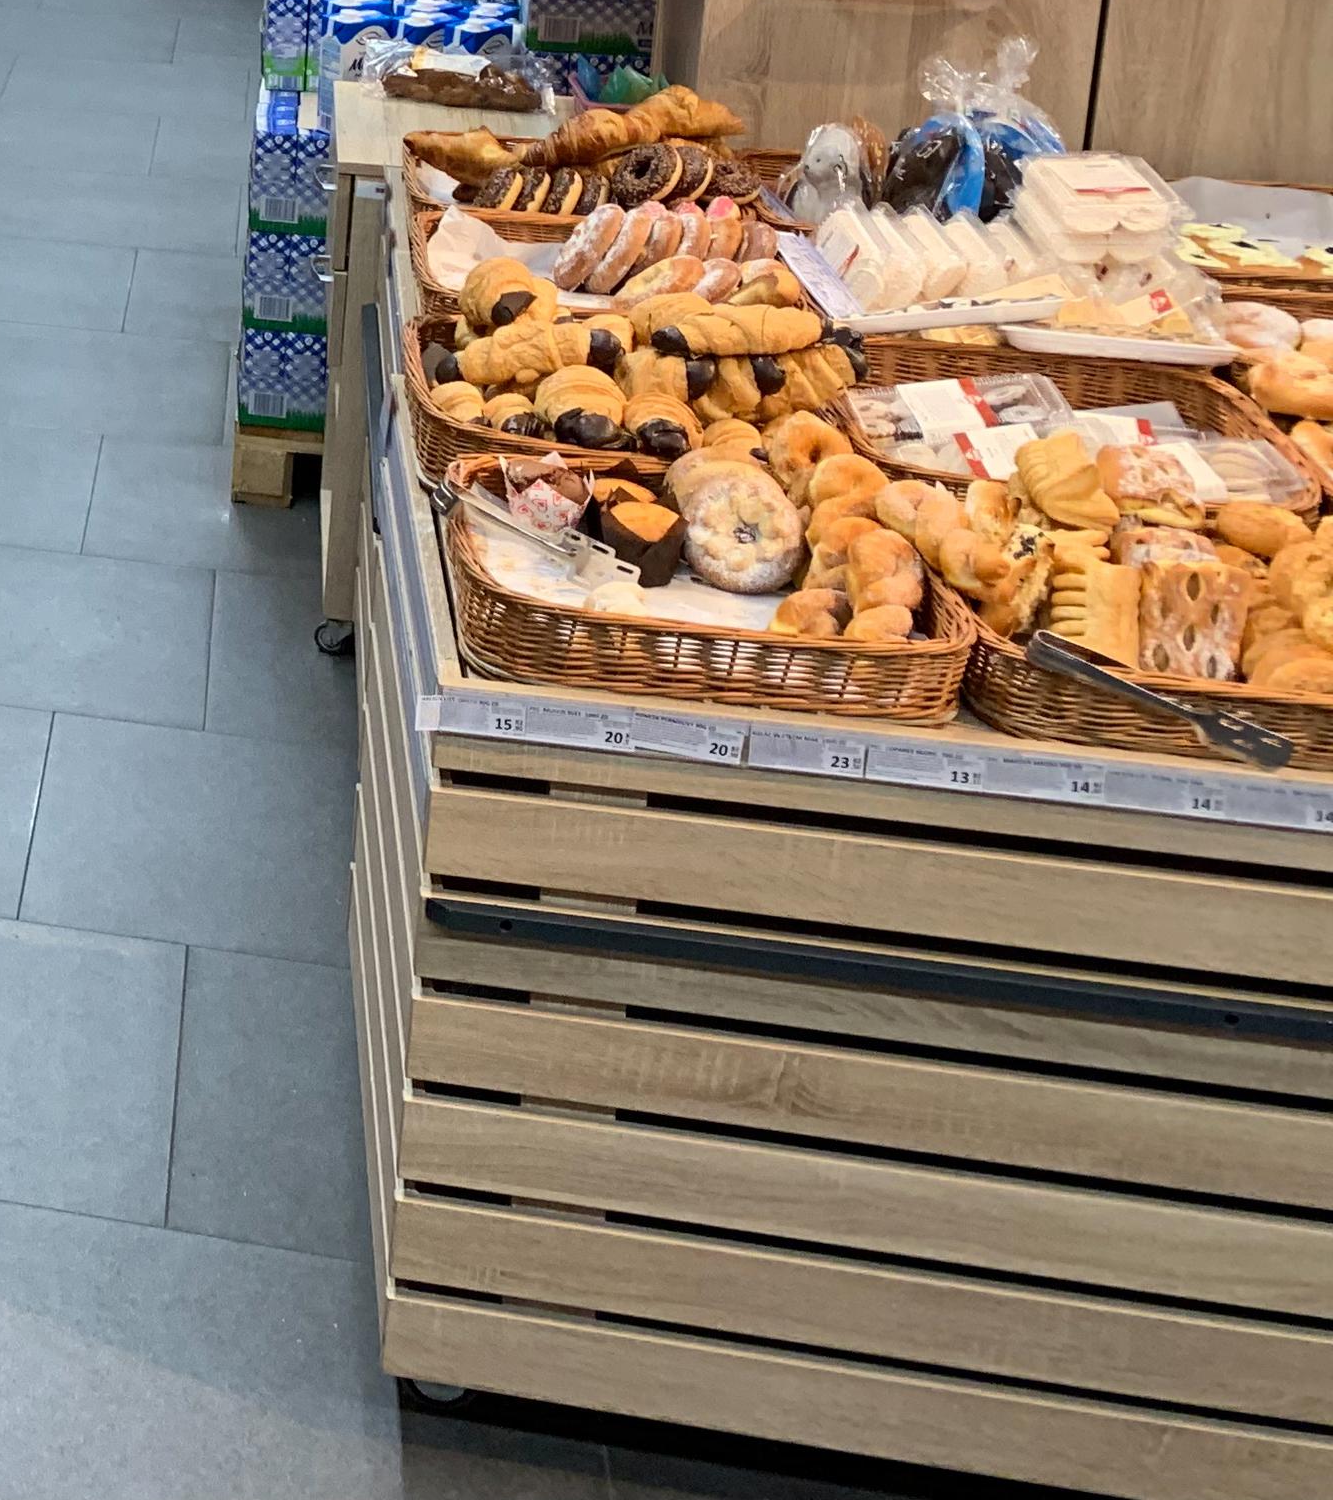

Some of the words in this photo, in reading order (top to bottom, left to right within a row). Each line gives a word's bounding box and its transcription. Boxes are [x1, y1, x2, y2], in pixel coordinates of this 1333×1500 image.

[495, 718, 512, 731] 15
[605, 731, 623, 744] 20
[709, 743, 729, 757] 20
[831, 756, 850, 769] 23
[951, 771, 969, 784] 13
[1070, 781, 1090, 793] 14
[1192, 798, 1211, 810] 14
